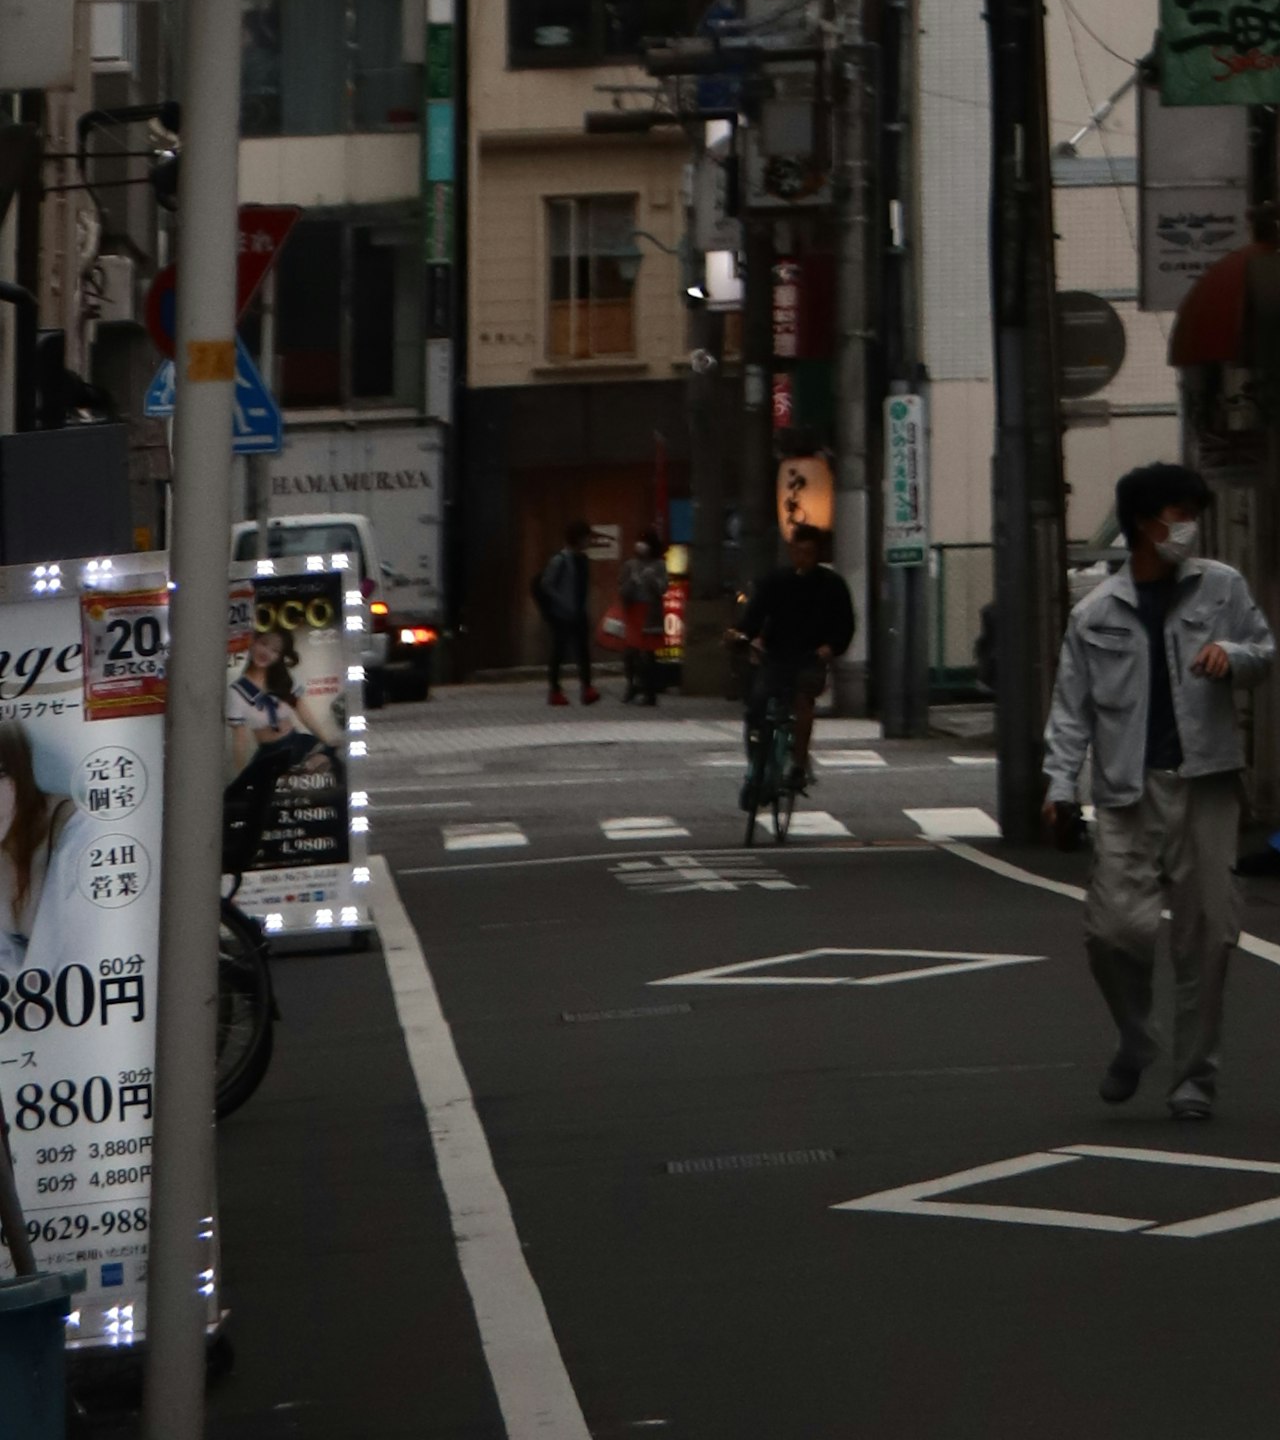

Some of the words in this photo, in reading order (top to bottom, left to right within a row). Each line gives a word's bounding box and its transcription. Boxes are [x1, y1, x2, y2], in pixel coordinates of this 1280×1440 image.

[272, 469, 432, 495] HAMAMURAYA
[86, 756, 135, 782] 完全
[88, 784, 136, 812] 個室
[89, 844, 137, 868] 24H
[90, 872, 139, 900] 営業
[99, 954, 146, 976] 60分
[118, 1067, 153, 1085] 30分
[36, 1144, 77, 1166] 30分
[36, 1173, 77, 1194] 50分
[27, 1208, 150, 1244] 9629-988
